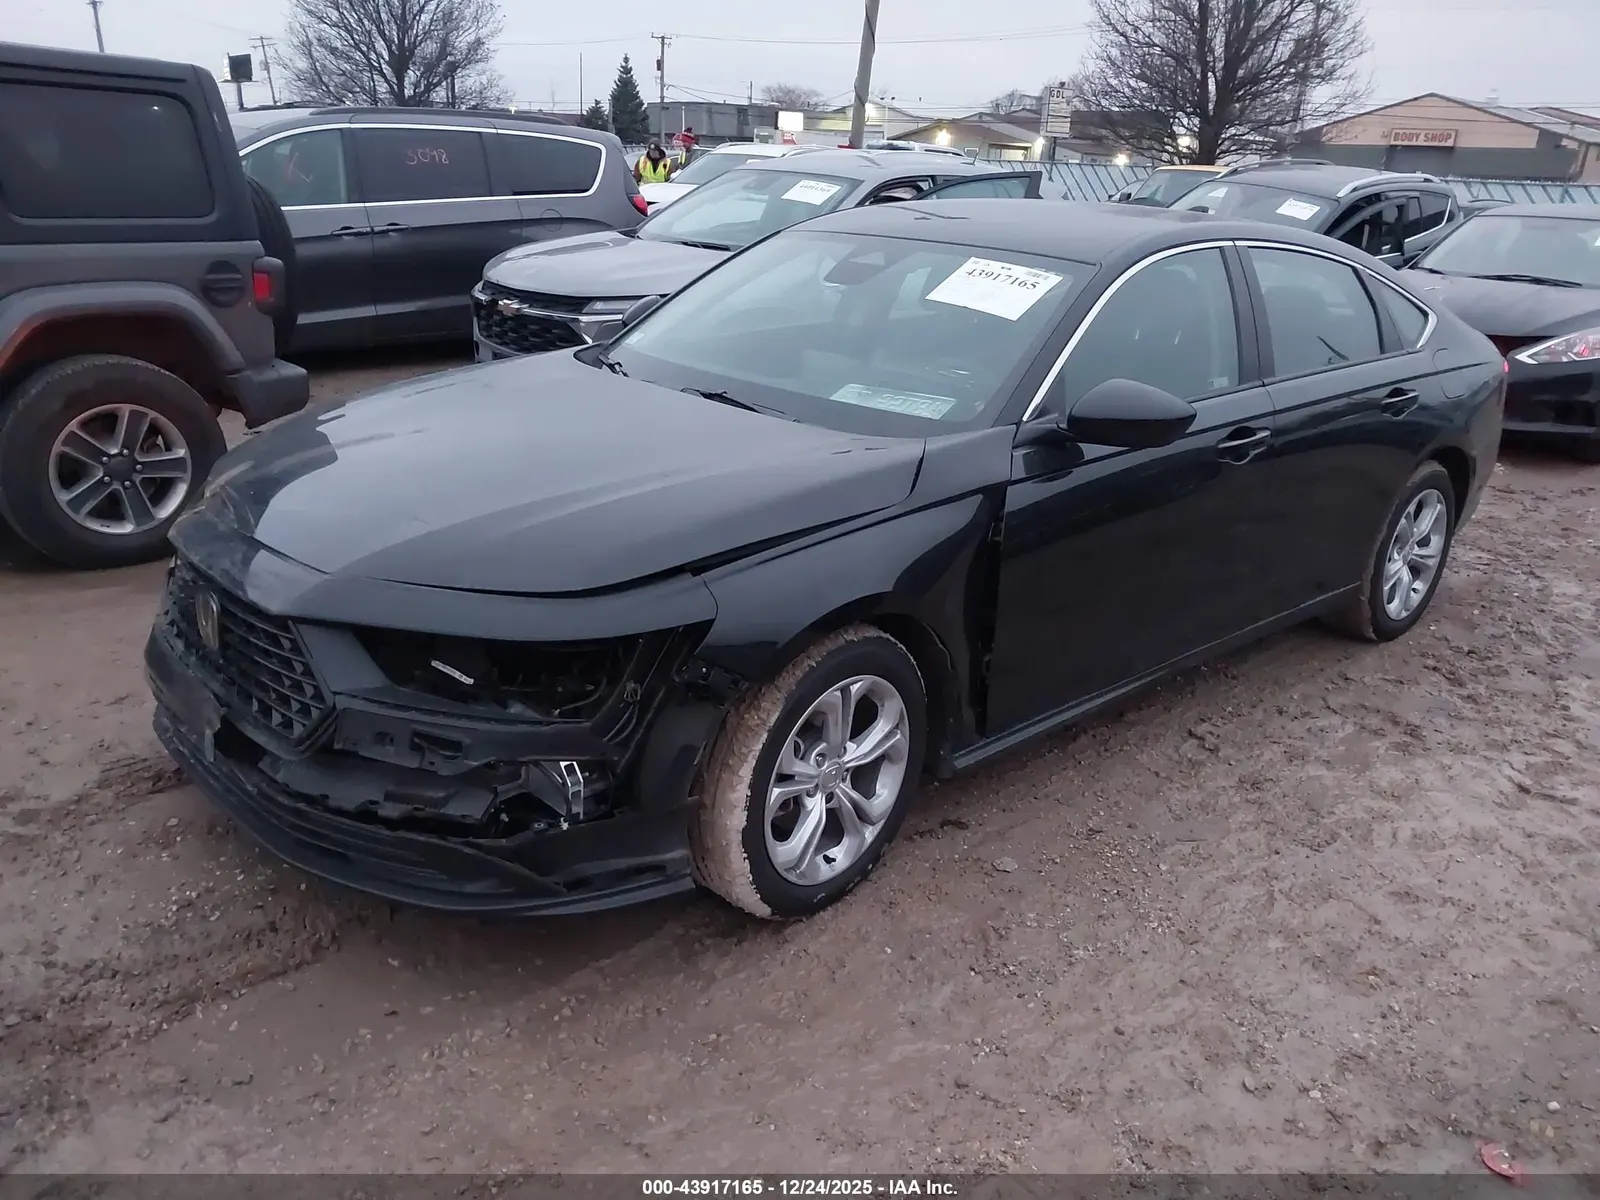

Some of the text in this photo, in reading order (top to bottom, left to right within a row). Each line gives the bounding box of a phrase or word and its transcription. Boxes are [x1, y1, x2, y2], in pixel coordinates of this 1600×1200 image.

[1393, 131, 1452, 143] BODY SHOP
[965, 267, 1041, 291] 43917165
